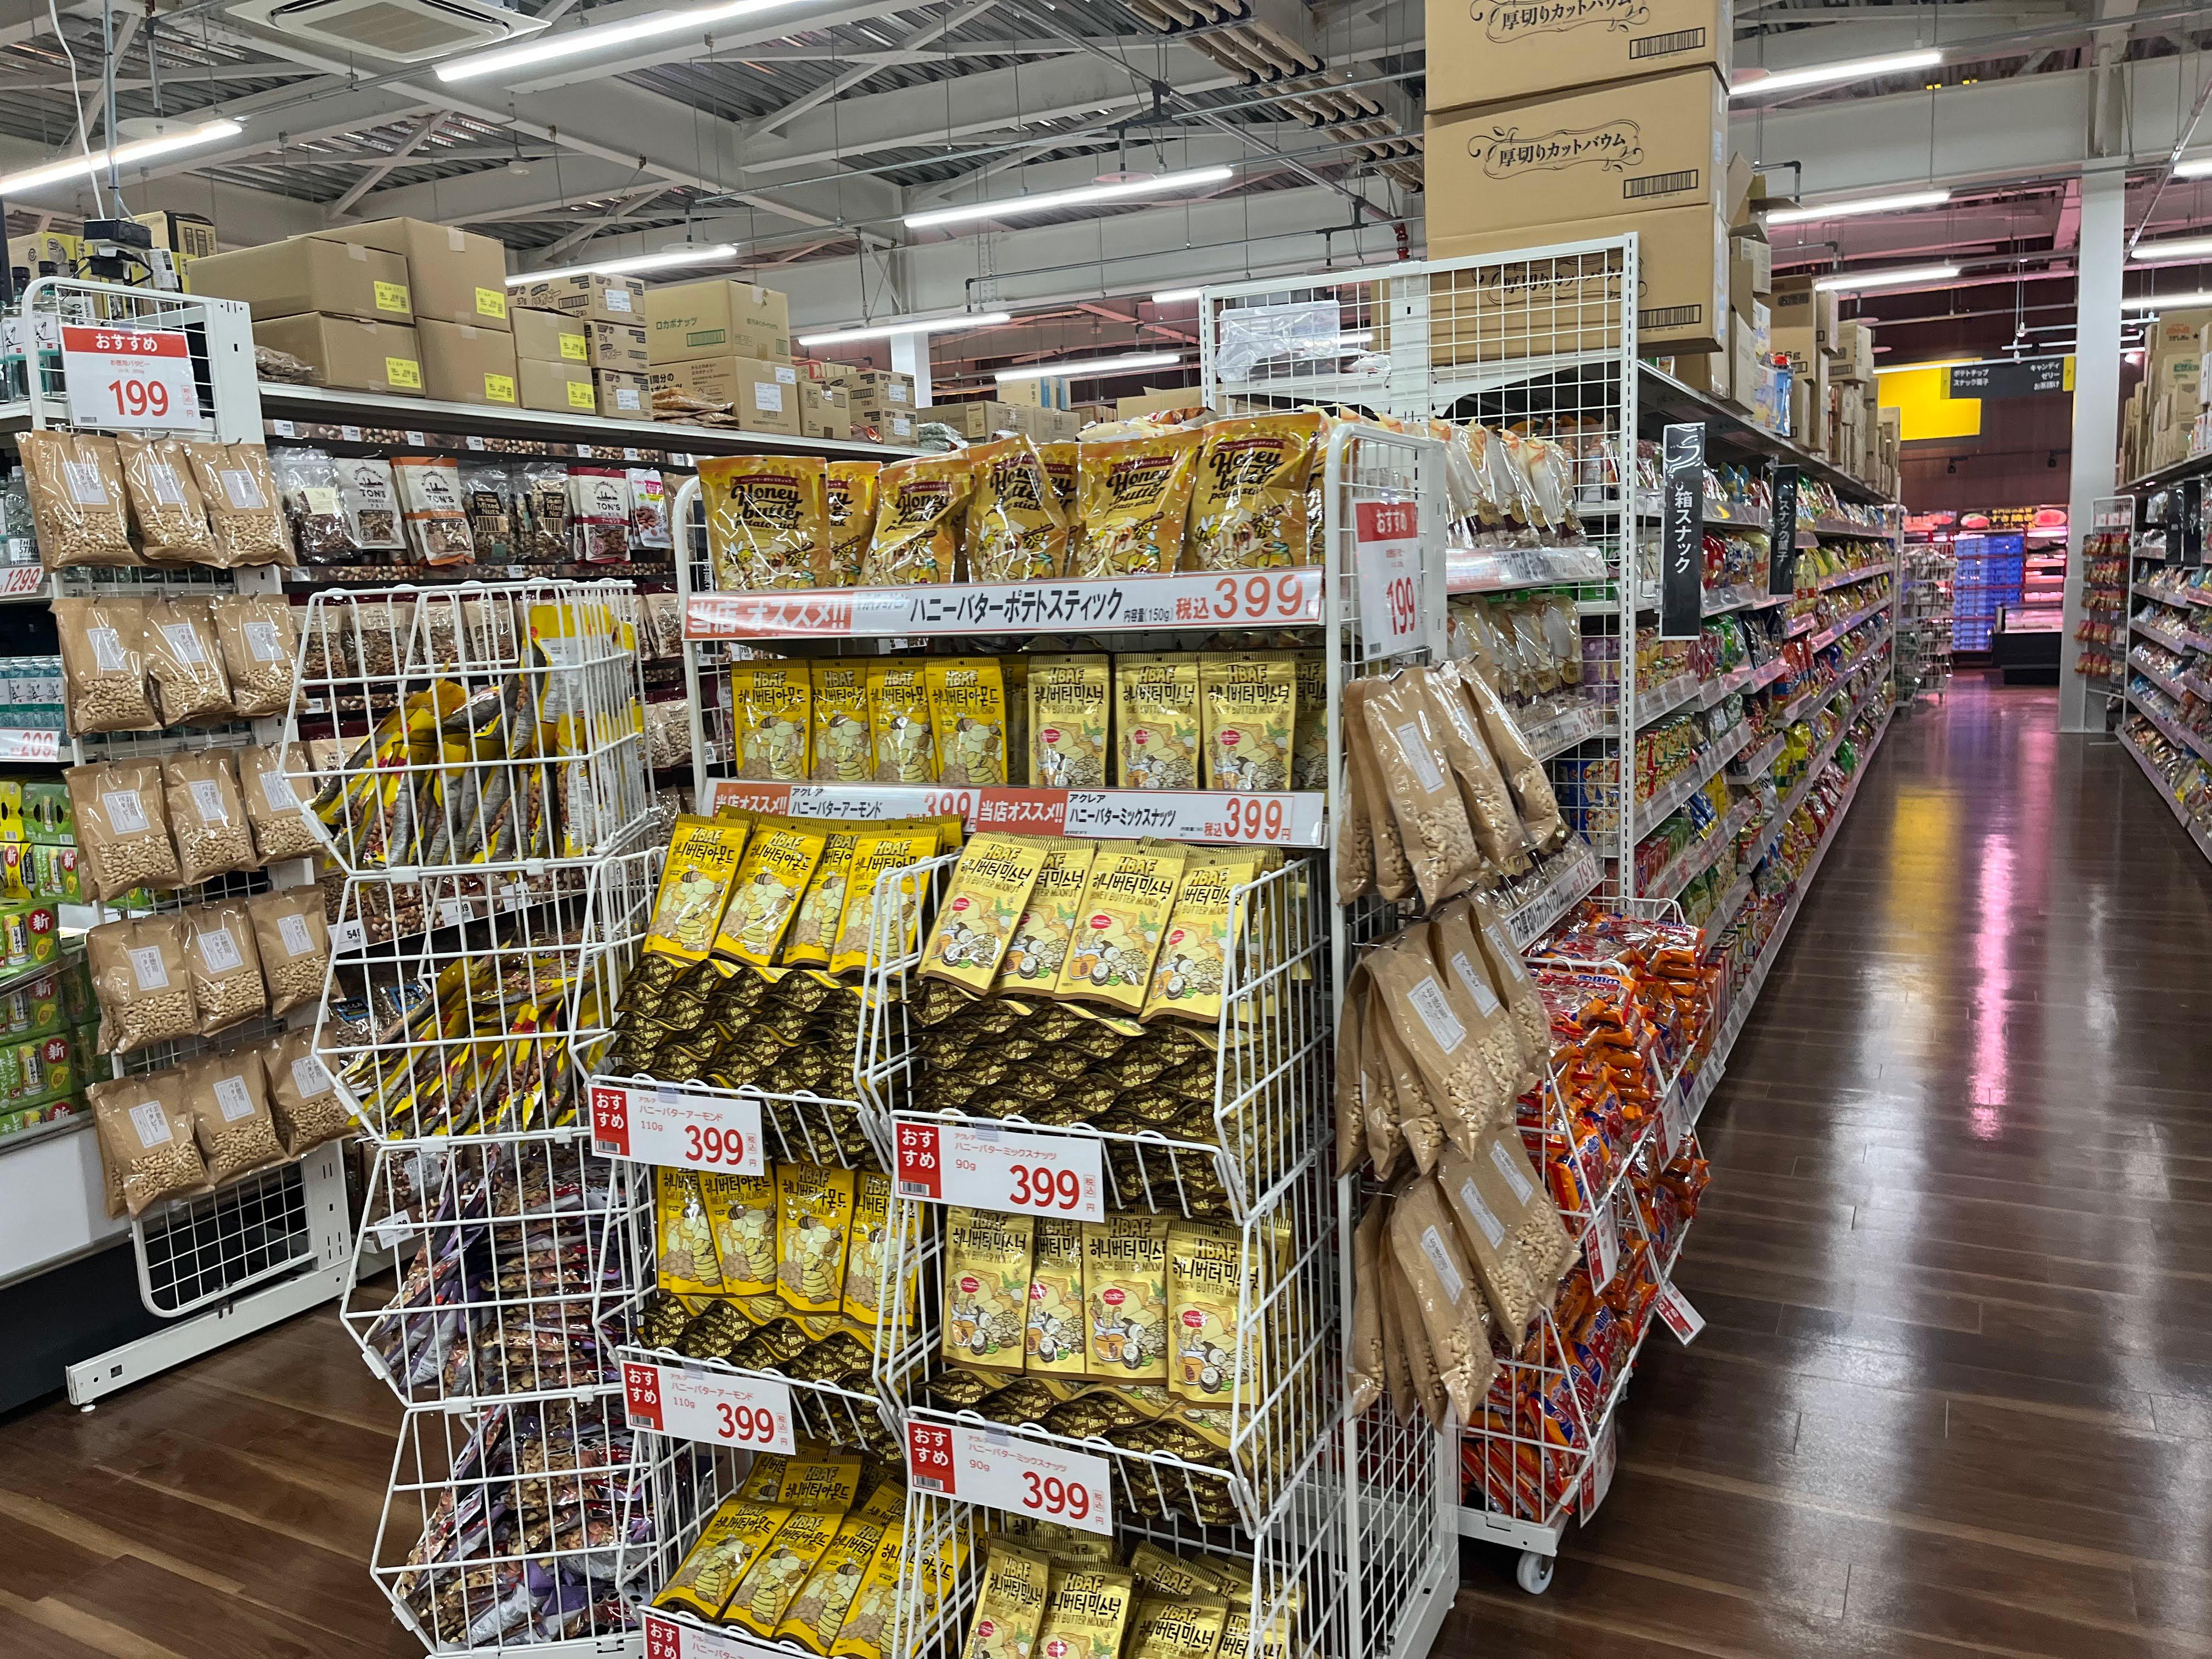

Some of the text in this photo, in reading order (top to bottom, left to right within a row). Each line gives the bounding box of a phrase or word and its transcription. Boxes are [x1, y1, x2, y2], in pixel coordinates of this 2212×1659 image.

[1499, 133, 1626, 167] 厚切りカットバウム
[656, 317, 697, 330] ロカボナッツ
[95, 333, 157, 352] おすすめ
[109, 380, 168, 416] 199
[1105, 467, 1171, 497] Honey
[426, 495, 454, 503] TON'S
[477, 501, 499, 510] Mixed
[730, 483, 803, 510] Honey
[482, 507, 500, 515] Nuts
[596, 502, 621, 511] TON'S
[1376, 509, 1407, 533] おすすめ
[1674, 490, 1693, 574] 箱スナック
[1776, 500, 1790, 563] スナック菓子
[4, 568, 40, 592] 1299
[910, 587, 1123, 624] ハニーバターポテトスティック
[1124, 607, 1174, 623] 内容量(150g)
[1176, 597, 1209, 620] 税込
[1213, 574, 1303, 619] 399
[1386, 576, 1415, 635] 199
[752, 670, 787, 689] HBAF
[823, 670, 856, 687] HBAF
[884, 669, 915, 687] HBAF
[945, 669, 979, 687] HBAF
[1048, 667, 1085, 685] HBAF
[1138, 664, 1177, 685] HBAF
[1227, 664, 1267, 685] HBAF
[1069, 793, 1105, 803] アクレア
[792, 800, 883, 820] ハニーバターアーモンド
[980, 800, 1064, 824] 当店オススメ!!
[1069, 808, 1176, 827] ハニーバターミックスナッツ
[1204, 798, 1291, 840] 税込 399 円
[689, 827, 724, 845] HBAF
[769, 831, 806, 850] HBAF
[7, 849, 16, 864] 新
[873, 840, 912, 856] HBAF
[983, 843, 1023, 864] HBAF
[64, 853, 74, 868] 新
[1115, 856, 1158, 877] HBAF
[1189, 867, 1230, 887] HBAF
[32, 913, 49, 931] 新
[35, 980, 52, 997] 新
[929, 1003, 950, 1017] HBAF
[48, 1042, 65, 1060] 新
[596, 1092, 623, 1111] おす
[597, 1112, 624, 1130] すめ
[640, 1105, 723, 1121] ハニーバターアーモンド
[641, 1121, 743, 1166] 110g 399
[902, 1128, 935, 1148] おす
[903, 1148, 936, 1170] すめ
[955, 1142, 1057, 1161] ハニーバターミックスナッツ
[749, 1159, 756, 1167] 円
[797, 1163, 831, 1184] HBAF
[956, 1159, 1080, 1211] 90g 399
[1086, 1203, 1094, 1212] 円
[1109, 1217, 1152, 1239] HBAF
[1088, 1238, 1166, 1261] 허니버터믹스
[1194, 1237, 1237, 1263] HBAF
[1195, 1282, 1224, 1296] BUTTER
[628, 1369, 655, 1386] おす
[630, 1387, 657, 1405] すめ
[672, 1382, 754, 1401] ハニーバターアーモンド
[673, 1397, 775, 1444] 110g 399
[781, 1437, 788, 1446] 円
[914, 1428, 947, 1447] おす
[918, 1447, 949, 1466] すめ
[968, 1444, 1067, 1472] ハニーバターミックスナッツ
[803, 1466, 838, 1482] HBAF
[785, 1481, 849, 1502] 허니버터아몬드
[969, 1458, 1089, 1519] 90g 399
[788, 1514, 825, 1530] HBAF
[1095, 1515, 1104, 1525] 円
[1004, 1555, 1031, 1580] HBAF
[1064, 1572, 1104, 1592] HBAF
[1152, 1563, 1193, 1595] HBAF
[1159, 1604, 1201, 1626] HBAF
[650, 1622, 676, 1642] おす
[651, 1640, 677, 1659] すめ
